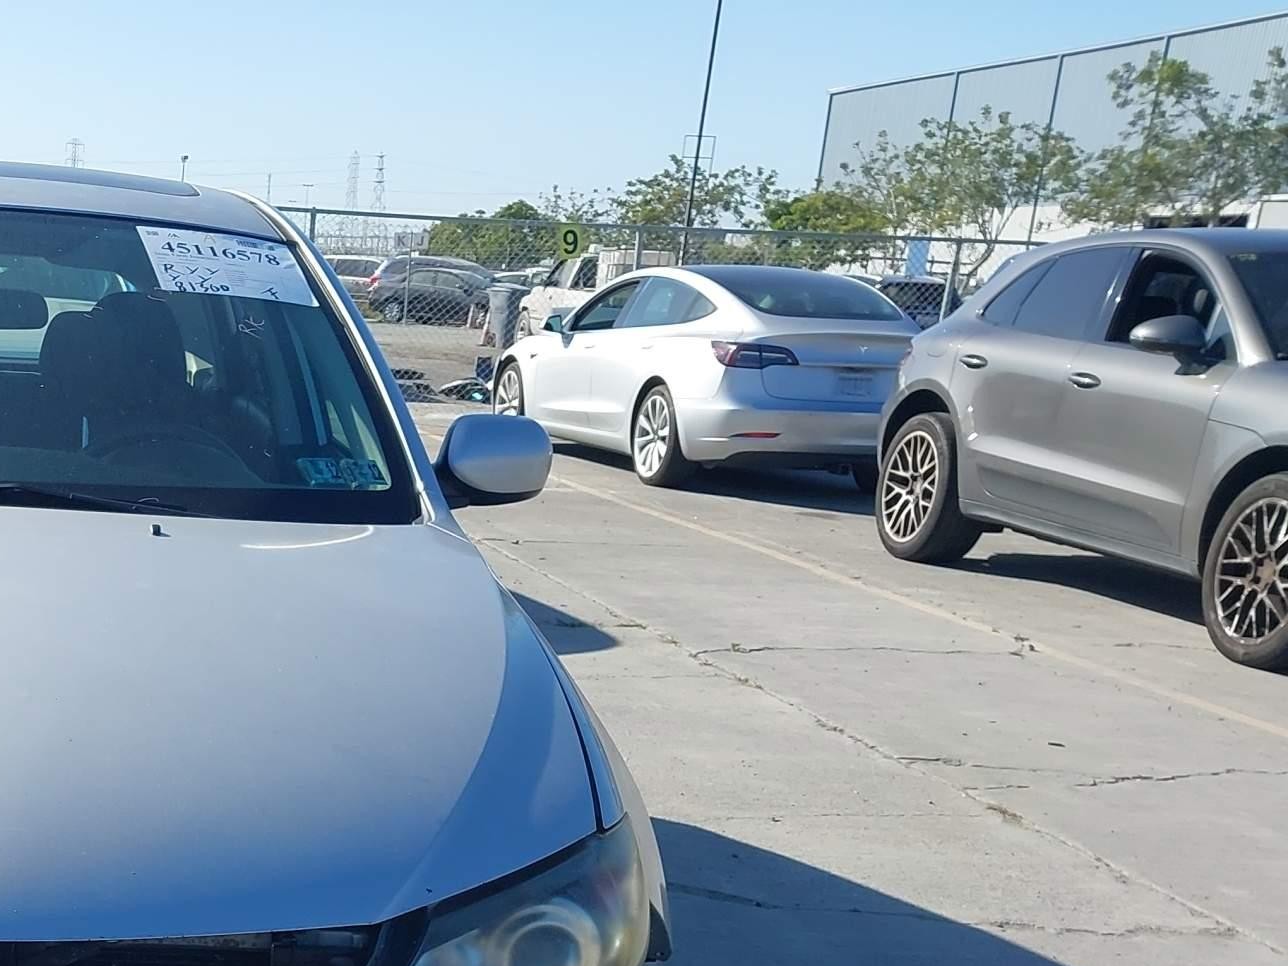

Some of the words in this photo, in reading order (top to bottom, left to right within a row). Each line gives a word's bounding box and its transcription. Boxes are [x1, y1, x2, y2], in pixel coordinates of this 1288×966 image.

[396, 235, 406, 247] K
[415, 235, 425, 247] J
[563, 229, 578, 255] 9
[161, 241, 281, 266] 45116578
